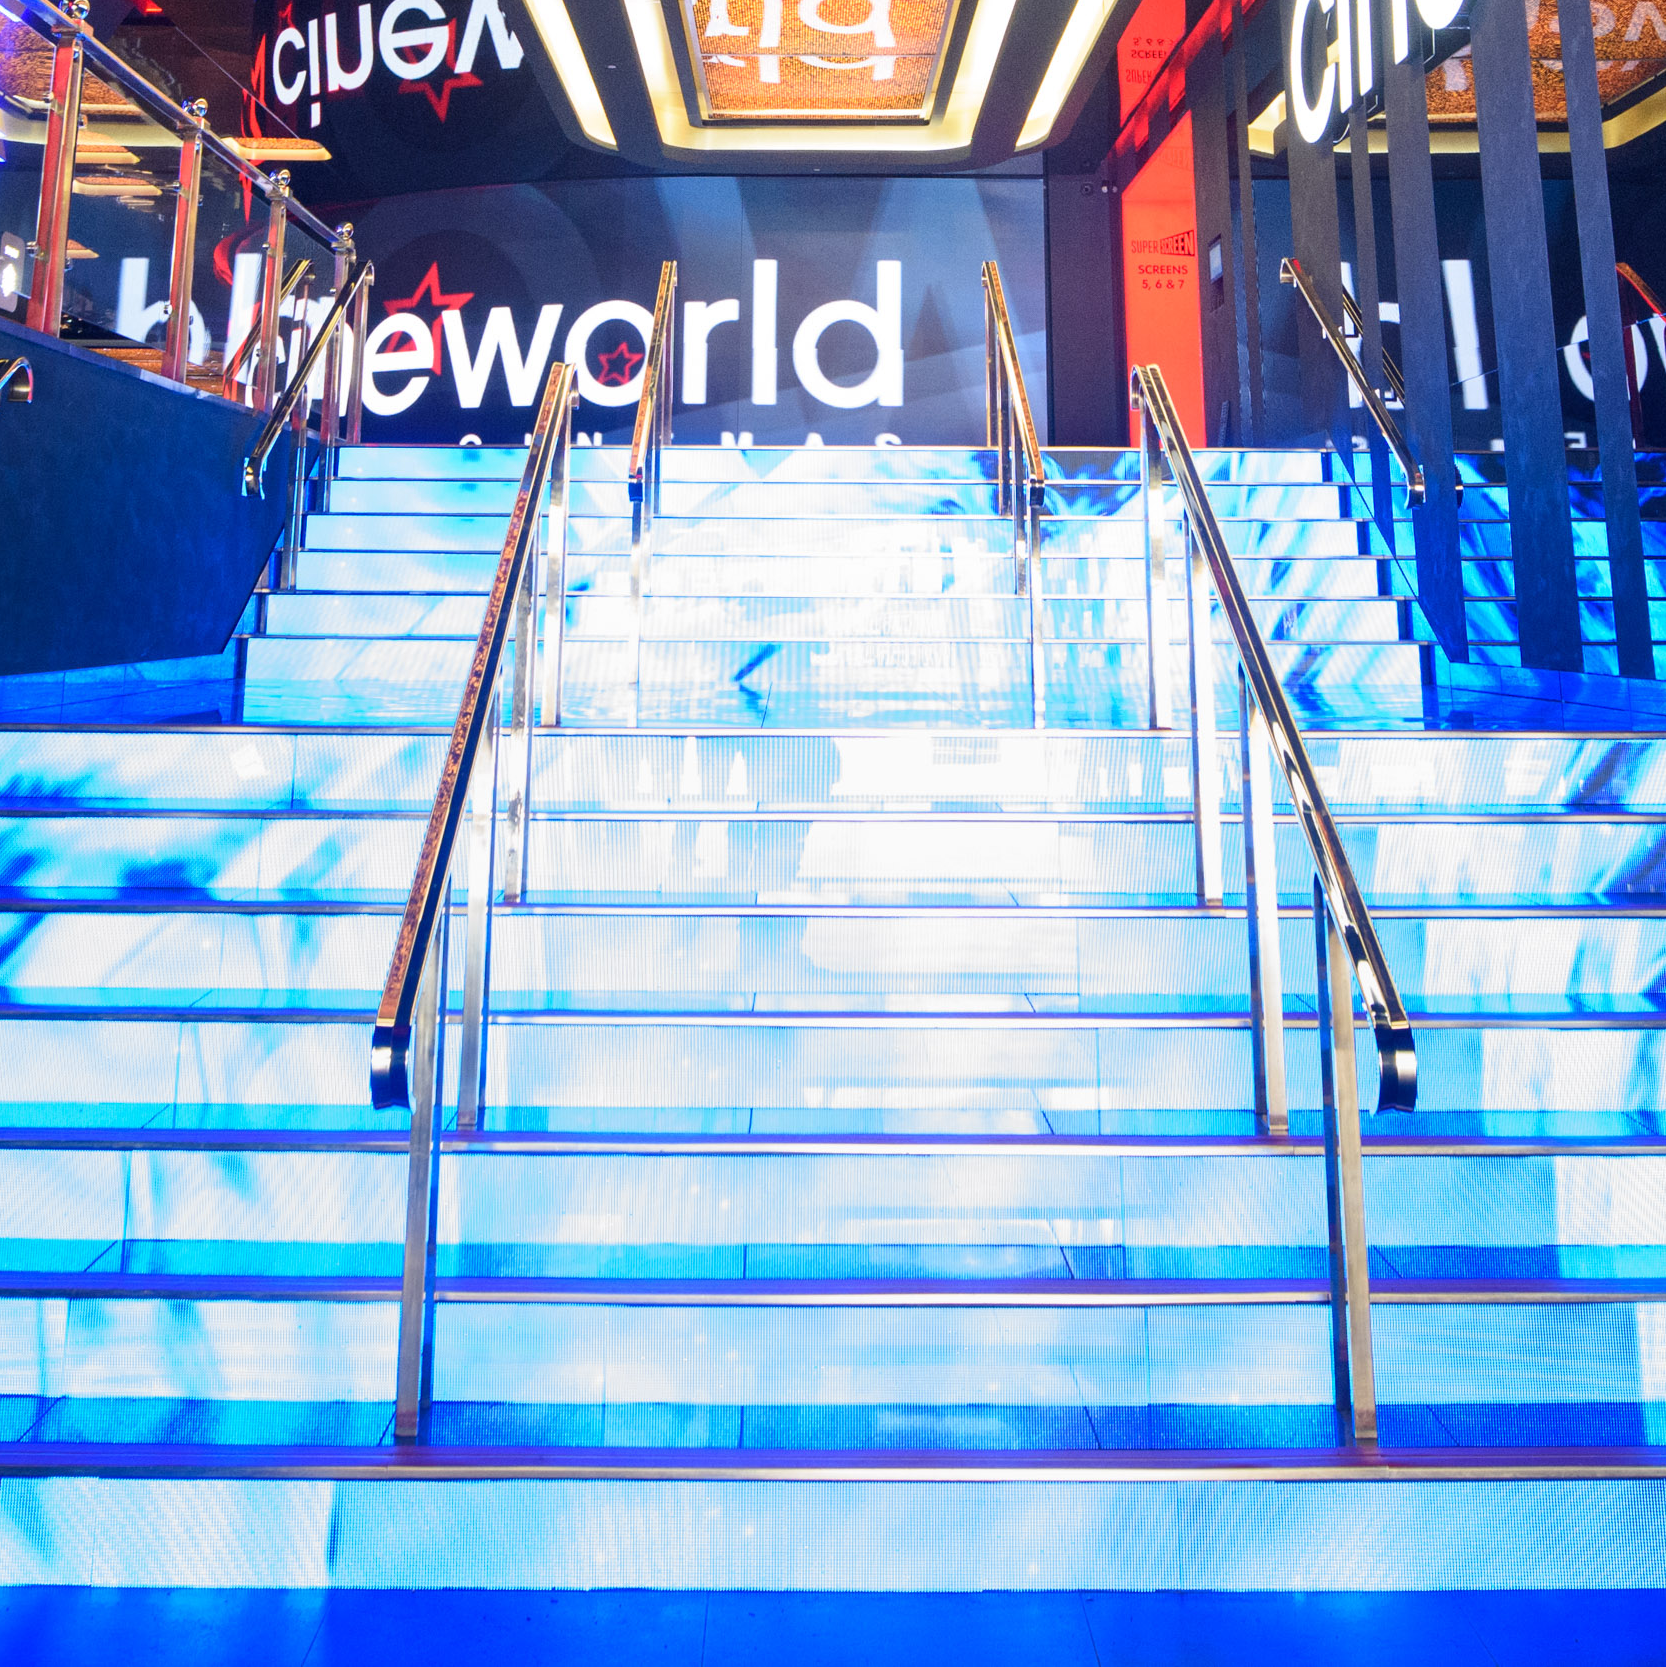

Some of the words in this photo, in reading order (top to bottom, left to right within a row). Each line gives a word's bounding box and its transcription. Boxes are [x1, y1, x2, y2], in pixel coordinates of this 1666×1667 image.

[1130, 239, 1159, 255] SUPER
[1160, 229, 1195, 256] SCREEN
[1138, 264, 1189, 276] SCREENS
[1141, 278, 1152, 290] 5,
[1155, 278, 1163, 289] 6
[1166, 278, 1175, 289] &
[1177, 278, 1185, 289] 7
